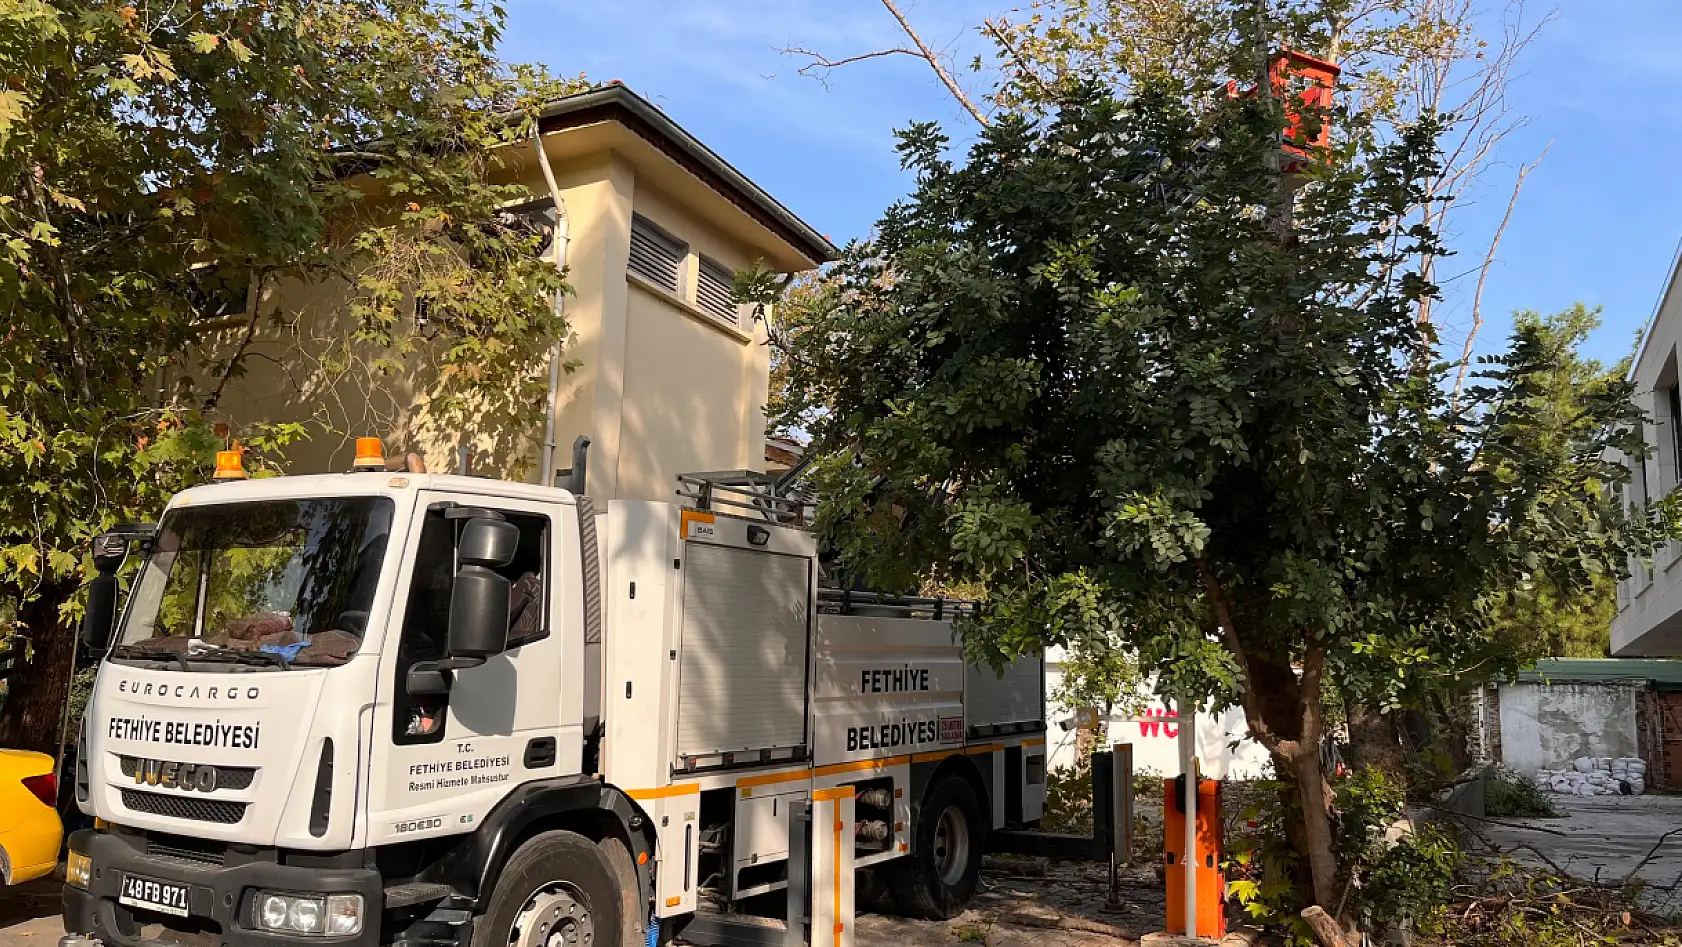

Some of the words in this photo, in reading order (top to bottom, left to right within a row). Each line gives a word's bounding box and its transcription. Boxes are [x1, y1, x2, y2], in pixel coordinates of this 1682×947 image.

[118, 680, 260, 700] EUROCARGO
[861, 664, 929, 694] FETHİYE
[108, 715, 161, 742] FETHİYE
[165, 719, 260, 749] BELEDİYESİ
[846, 715, 940, 752] BELEDİYESİ
[457, 743, 475, 753] T.C.
[135, 758, 220, 793] IVECO
[409, 760, 453, 775] FETHİYE
[455, 754, 510, 771] BELEDİYESİ
[408, 780, 435, 792] Resmi
[437, 777, 468, 789] Hizmete
[470, 773, 510, 785] Mahsustur
[128, 878, 143, 898] 48
[144, 881, 160, 902] FB
[162, 885, 187, 908] 971
